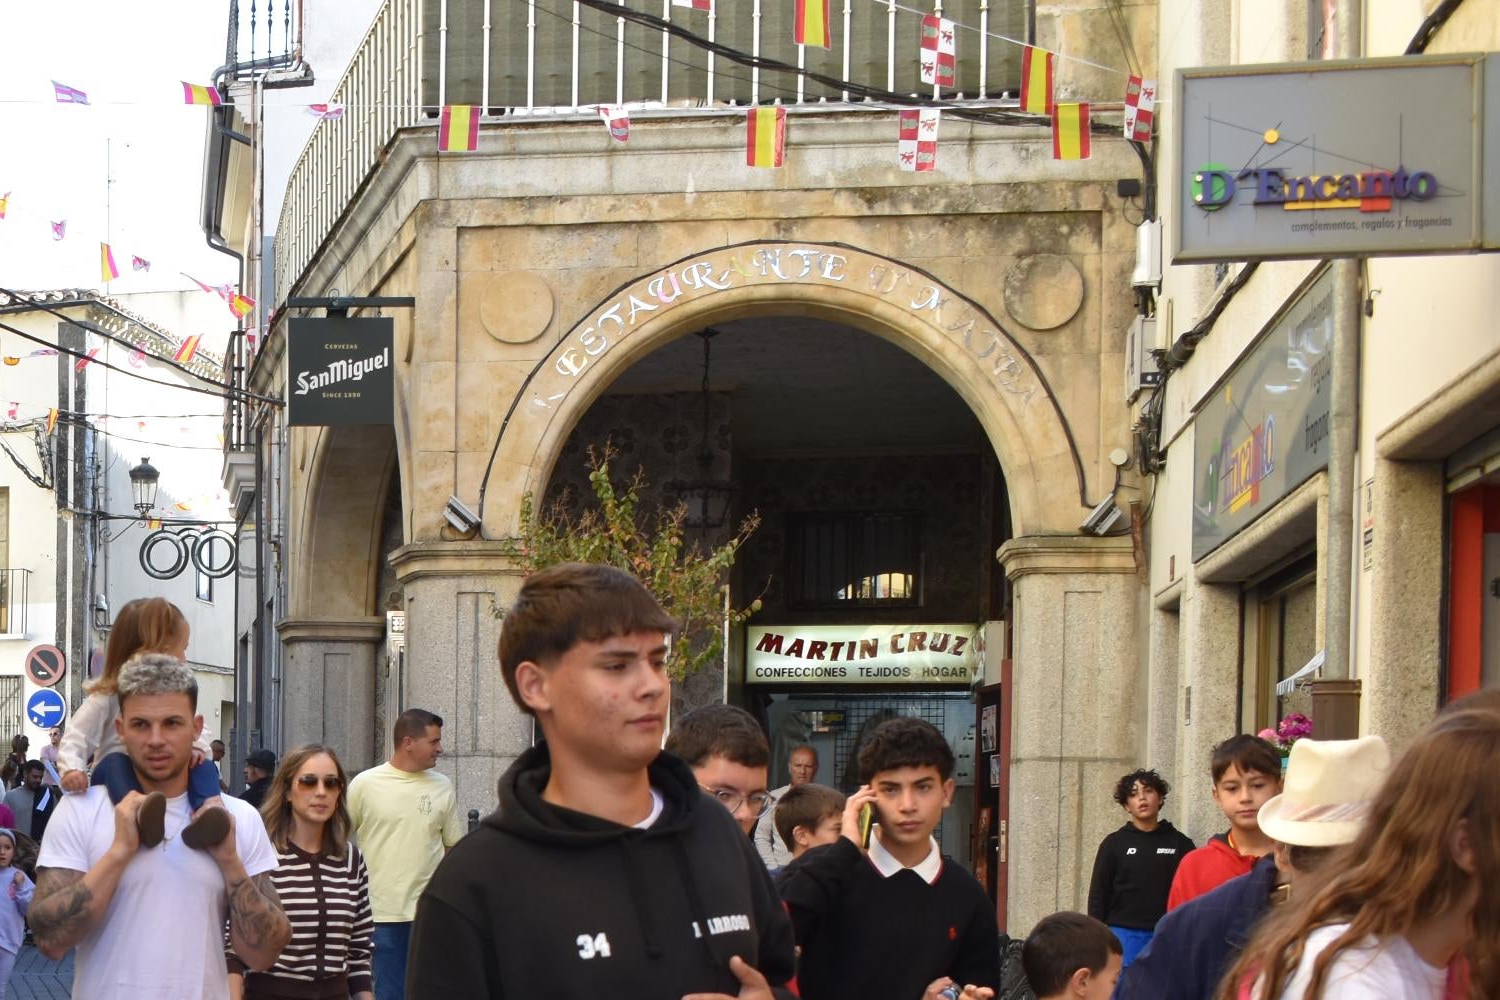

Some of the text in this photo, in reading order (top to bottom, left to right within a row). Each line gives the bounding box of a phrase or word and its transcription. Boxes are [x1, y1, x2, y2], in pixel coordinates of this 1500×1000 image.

[755, 631, 969, 662] MARTIN CRUZ
[755, 666, 968, 678] CONFECCIONES TEJIDOS HOGAR
[576, 932, 611, 960] 34
